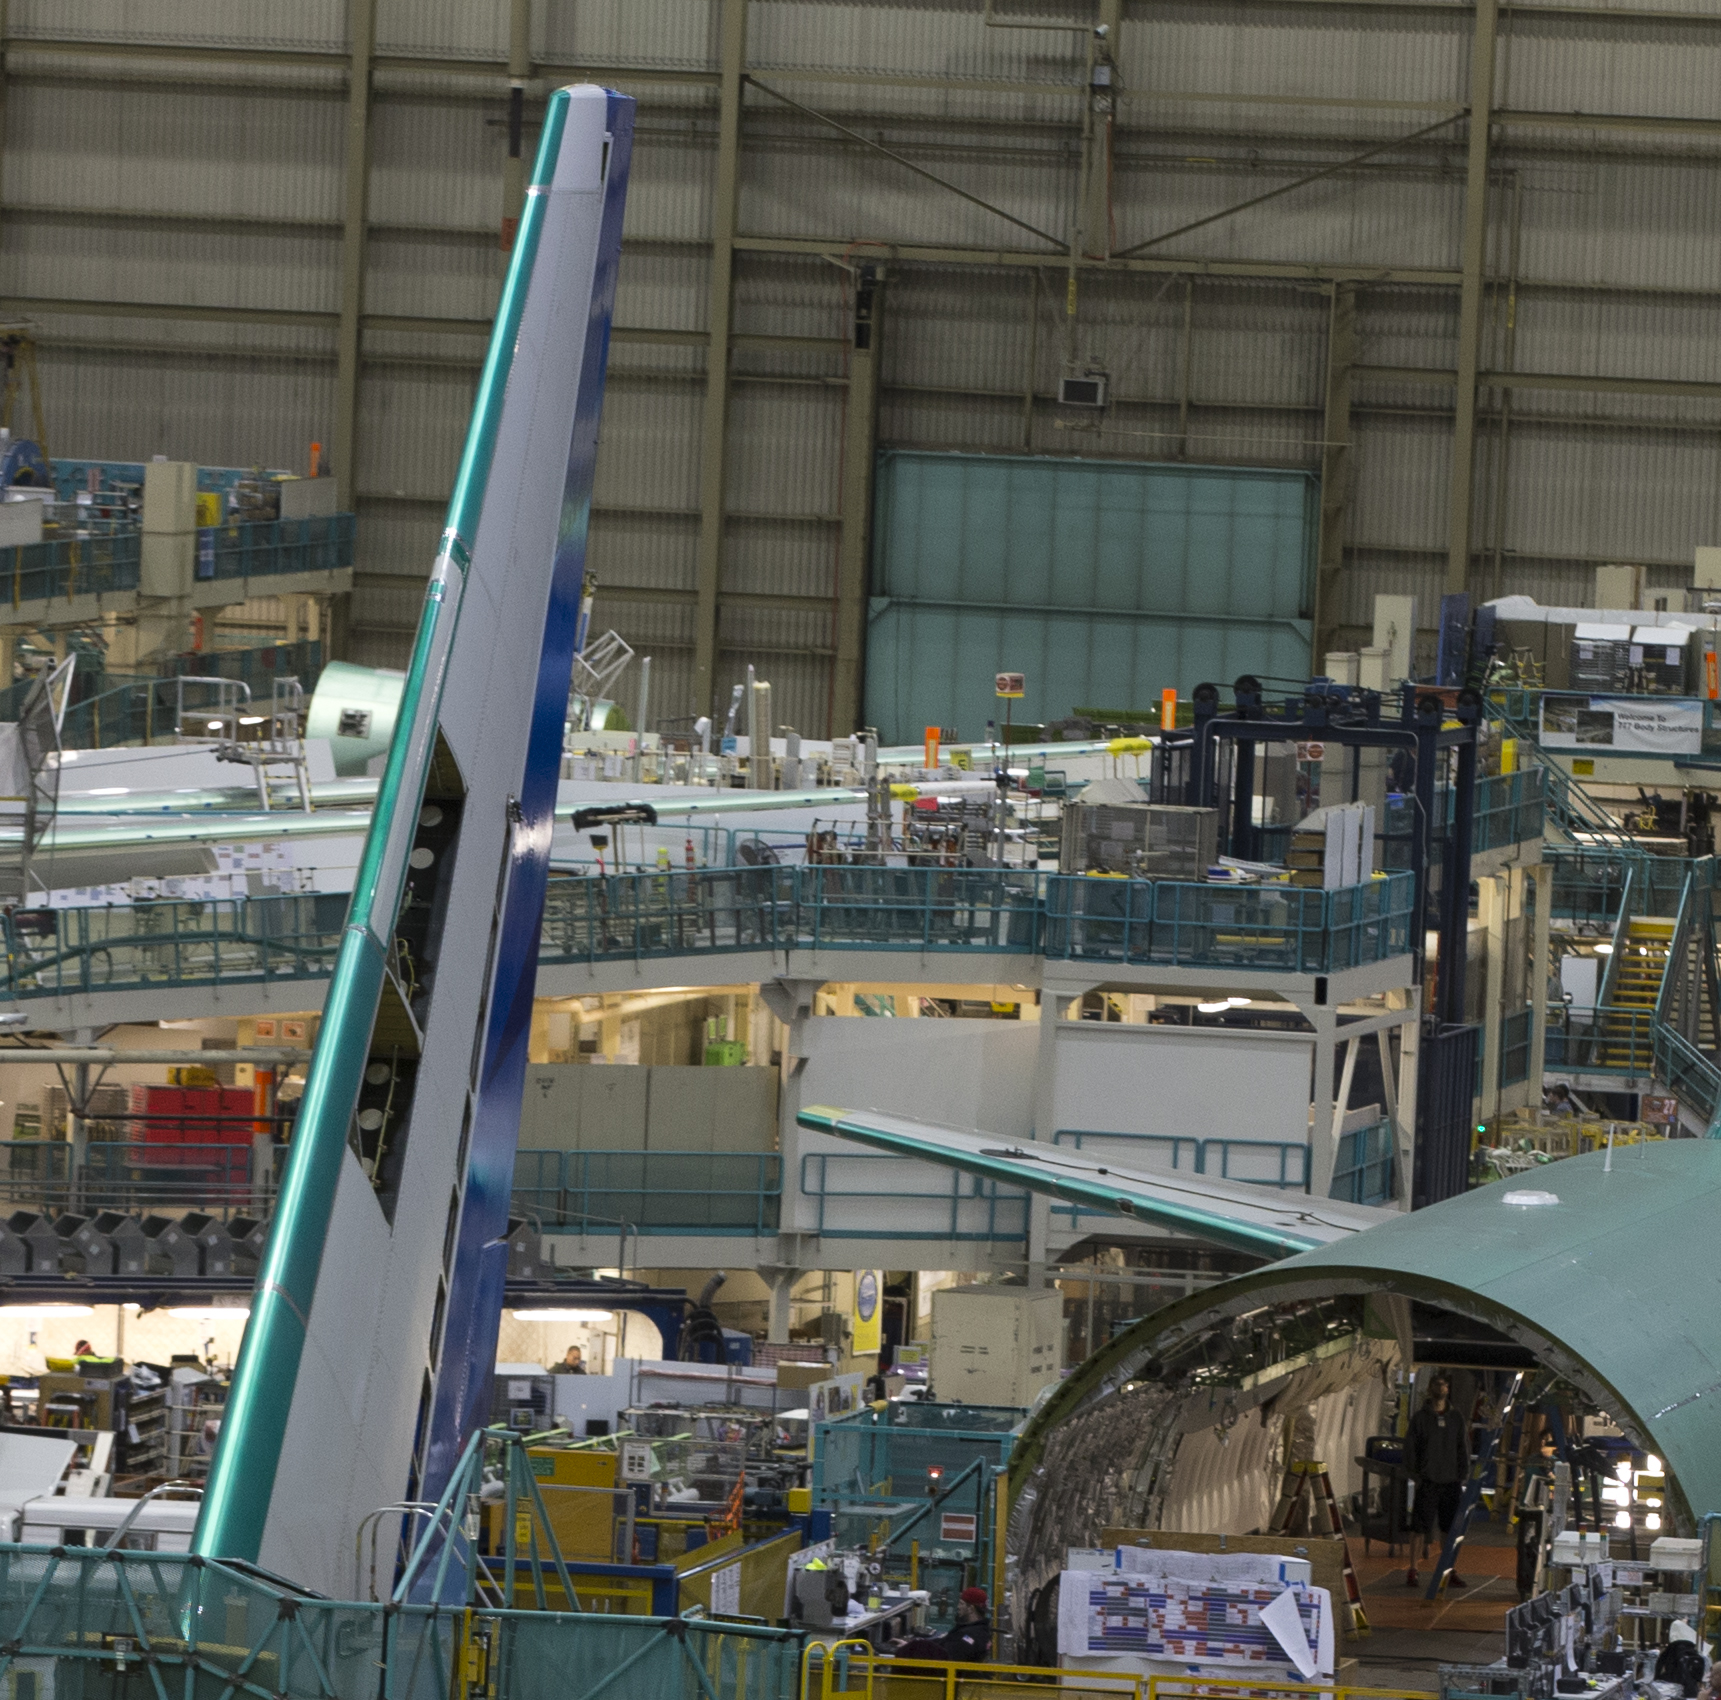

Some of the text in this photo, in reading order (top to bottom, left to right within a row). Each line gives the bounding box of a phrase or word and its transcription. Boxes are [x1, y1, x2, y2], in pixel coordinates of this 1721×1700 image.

[1617, 713, 1655, 722] Welcome
[1634, 723, 1655, 733] Body
[1657, 724, 1699, 734] Structures
[1663, 1098, 1677, 1115] 27
